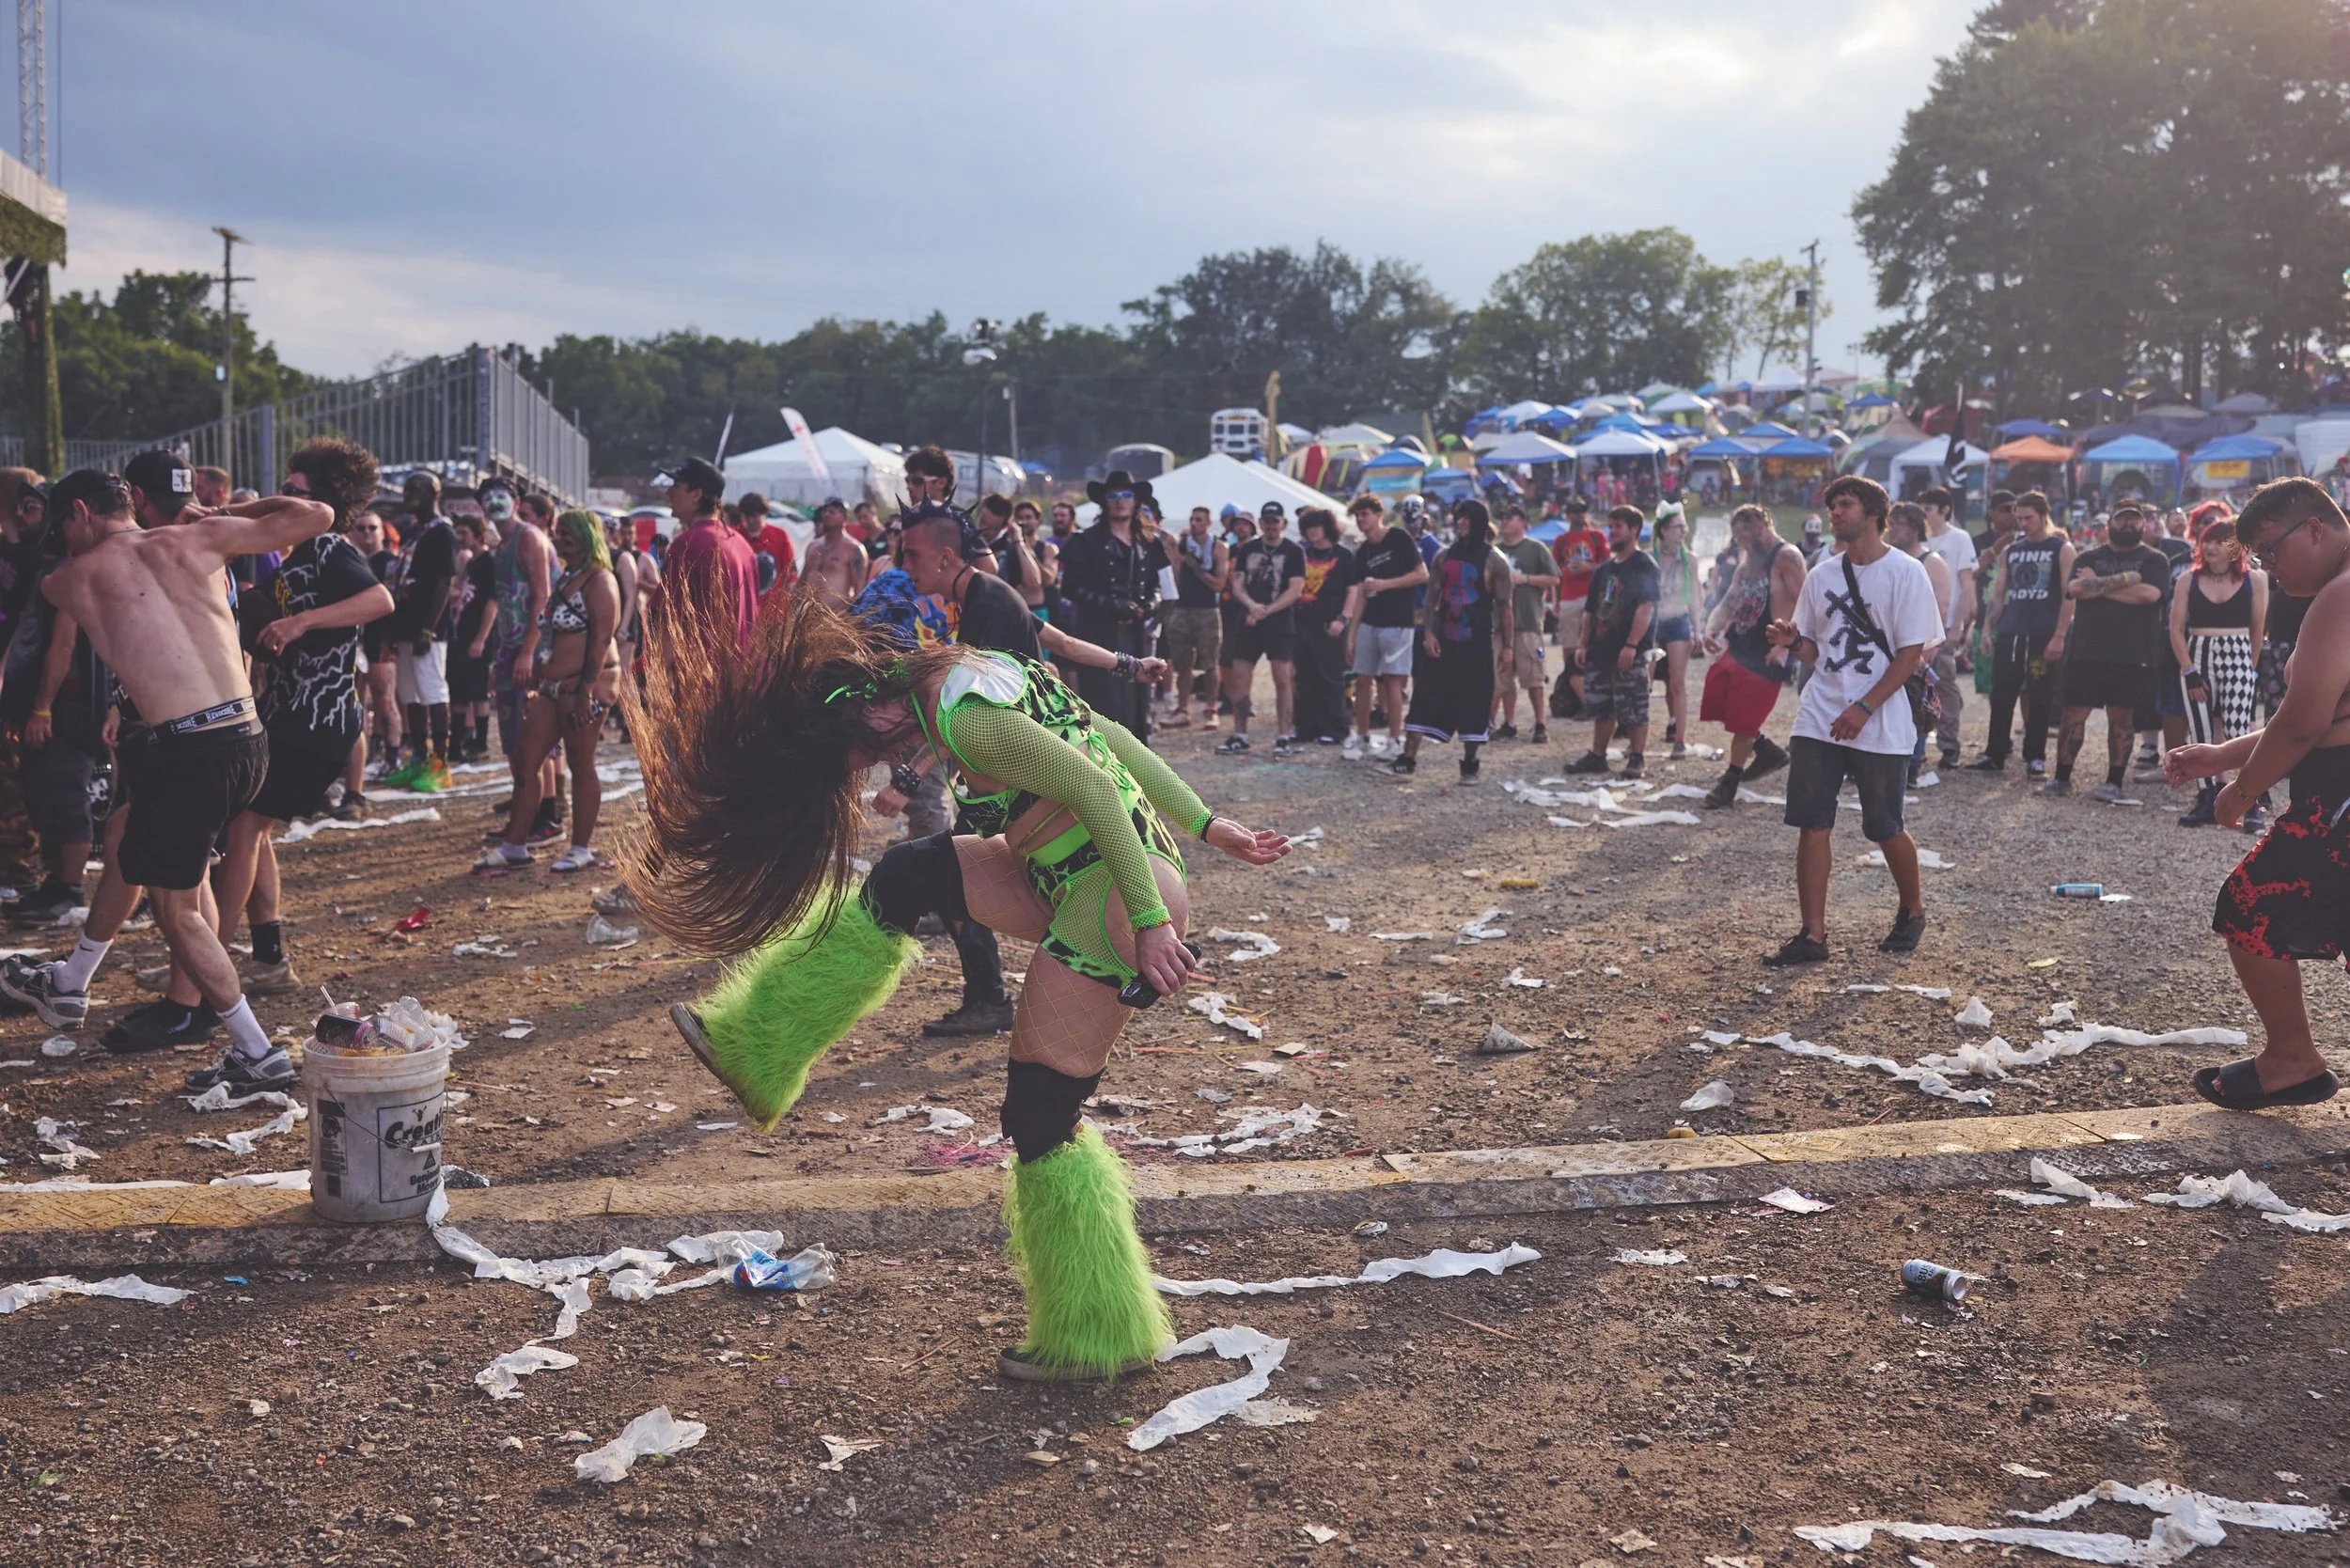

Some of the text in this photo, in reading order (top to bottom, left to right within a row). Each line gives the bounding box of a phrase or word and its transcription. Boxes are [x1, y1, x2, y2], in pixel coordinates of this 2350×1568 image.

[2008, 551, 2053, 563] PINK
[2009, 588, 2049, 601] OYD
[384, 1106, 443, 1150] Creati
[1919, 1263, 1933, 1283] BUS
